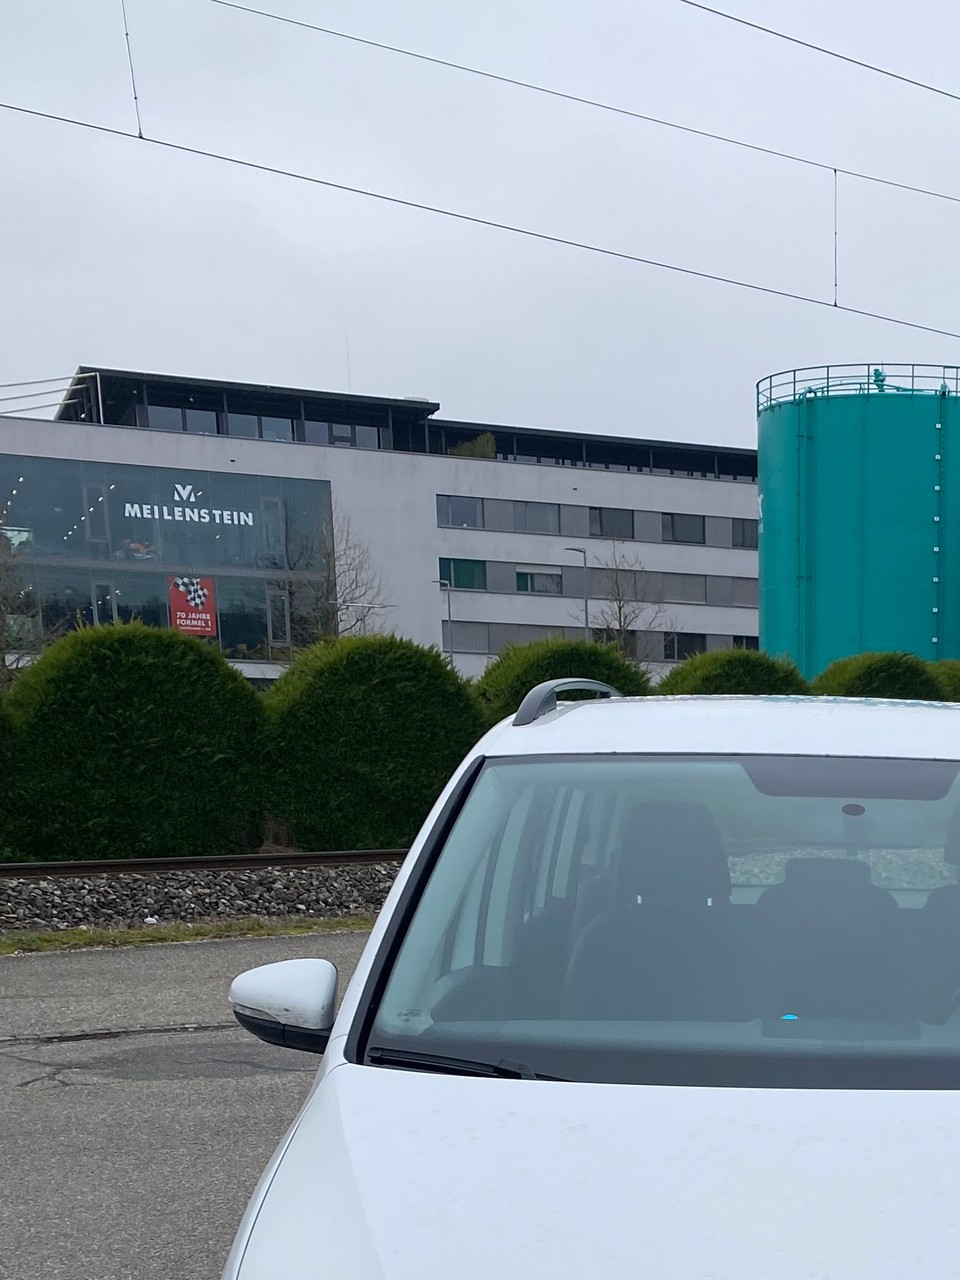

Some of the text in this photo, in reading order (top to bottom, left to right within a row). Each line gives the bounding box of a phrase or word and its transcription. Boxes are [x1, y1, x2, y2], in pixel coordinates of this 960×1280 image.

[124, 503, 253, 525] MEILENSTEIN
[188, 612, 211, 620] JAHRE
[176, 619, 206, 627] FORMEL
